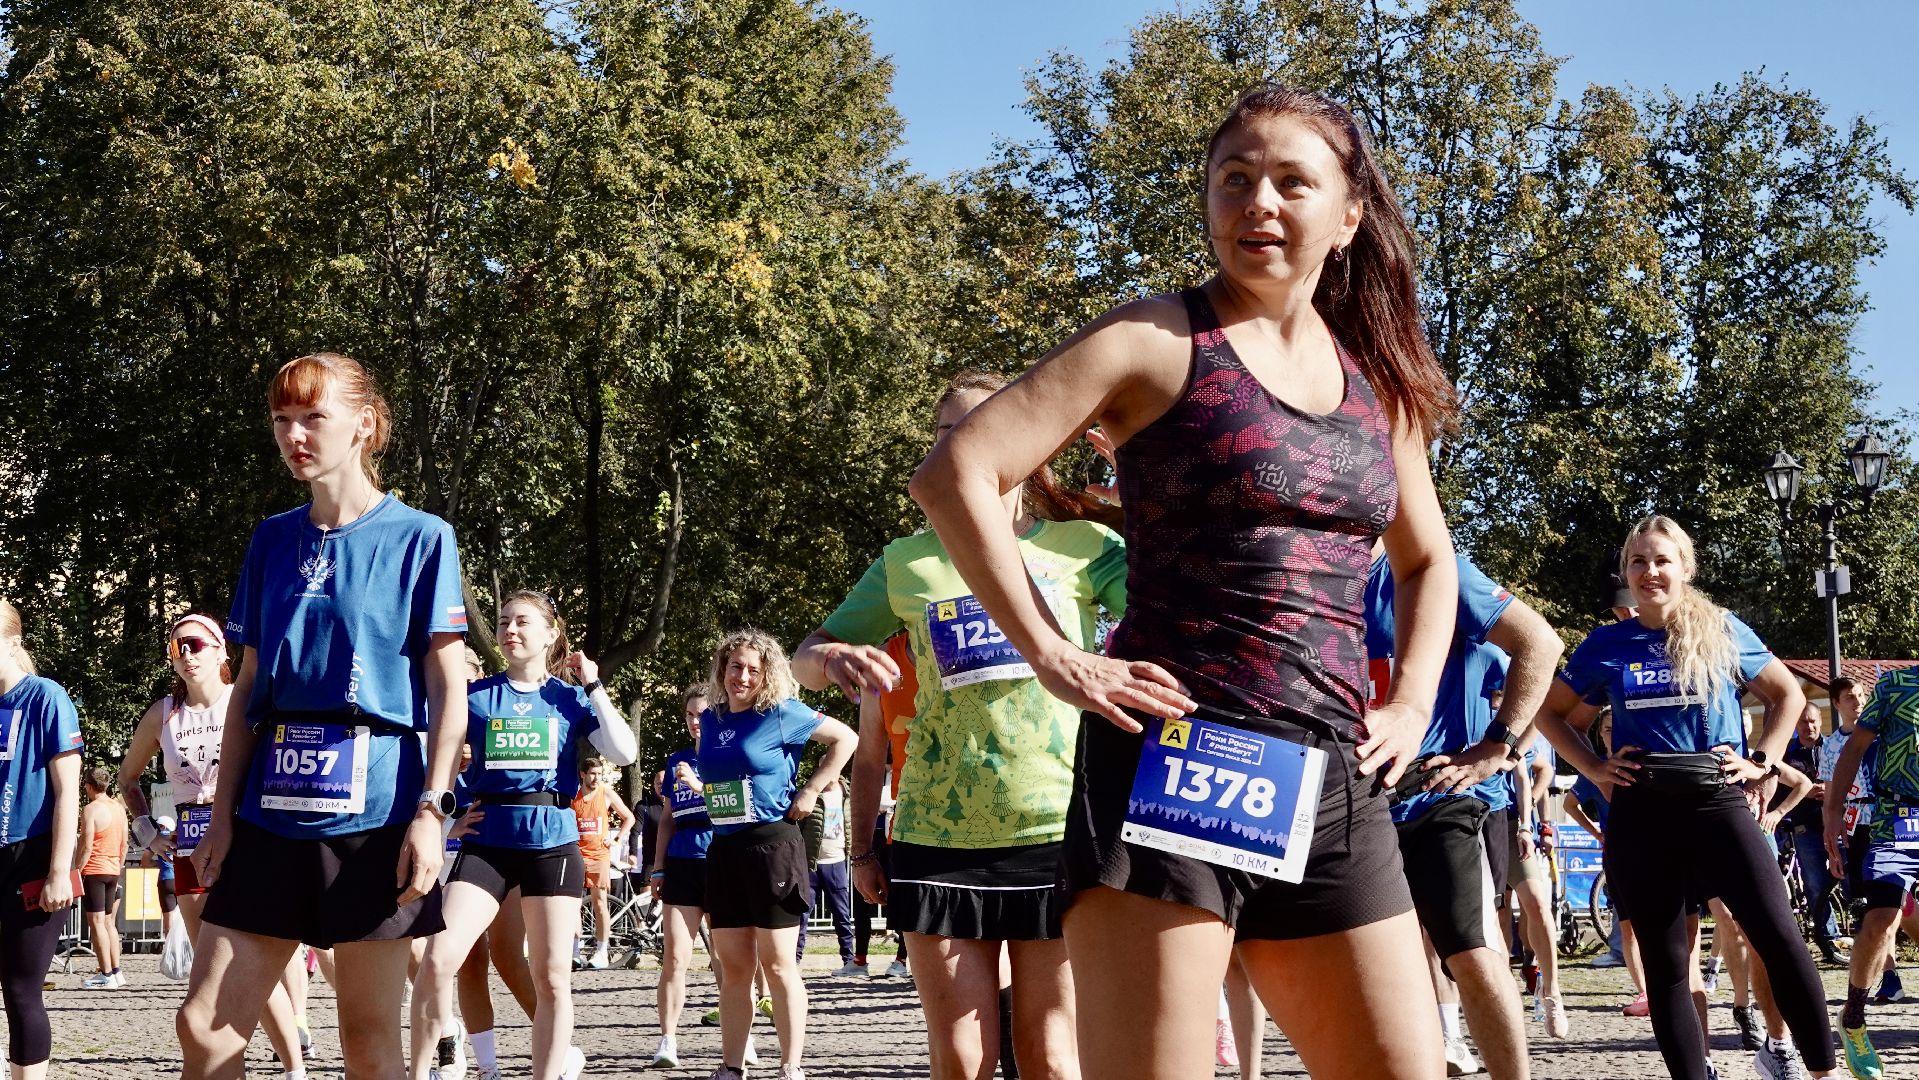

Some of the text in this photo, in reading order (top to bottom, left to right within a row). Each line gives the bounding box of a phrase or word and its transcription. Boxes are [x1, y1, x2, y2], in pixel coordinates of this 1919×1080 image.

[951, 618, 1007, 650] 125
[344, 652, 364, 703] бегут
[1633, 669, 1672, 685] 128
[175, 726, 203, 741] girls
[495, 732, 541, 749] 5102
[1166, 728, 1182, 744] А
[1204, 732, 1260, 752] Реки России
[275, 748, 339, 776] 1057
[1164, 756, 1277, 818] 1378
[1, 782, 14, 814] бегут
[315, 801, 324, 809] 10
[711, 793, 738, 808] 5116
[182, 823, 210, 838] 105
[1904, 819, 1919, 832] 11
[1233, 853, 1244, 866] 10
